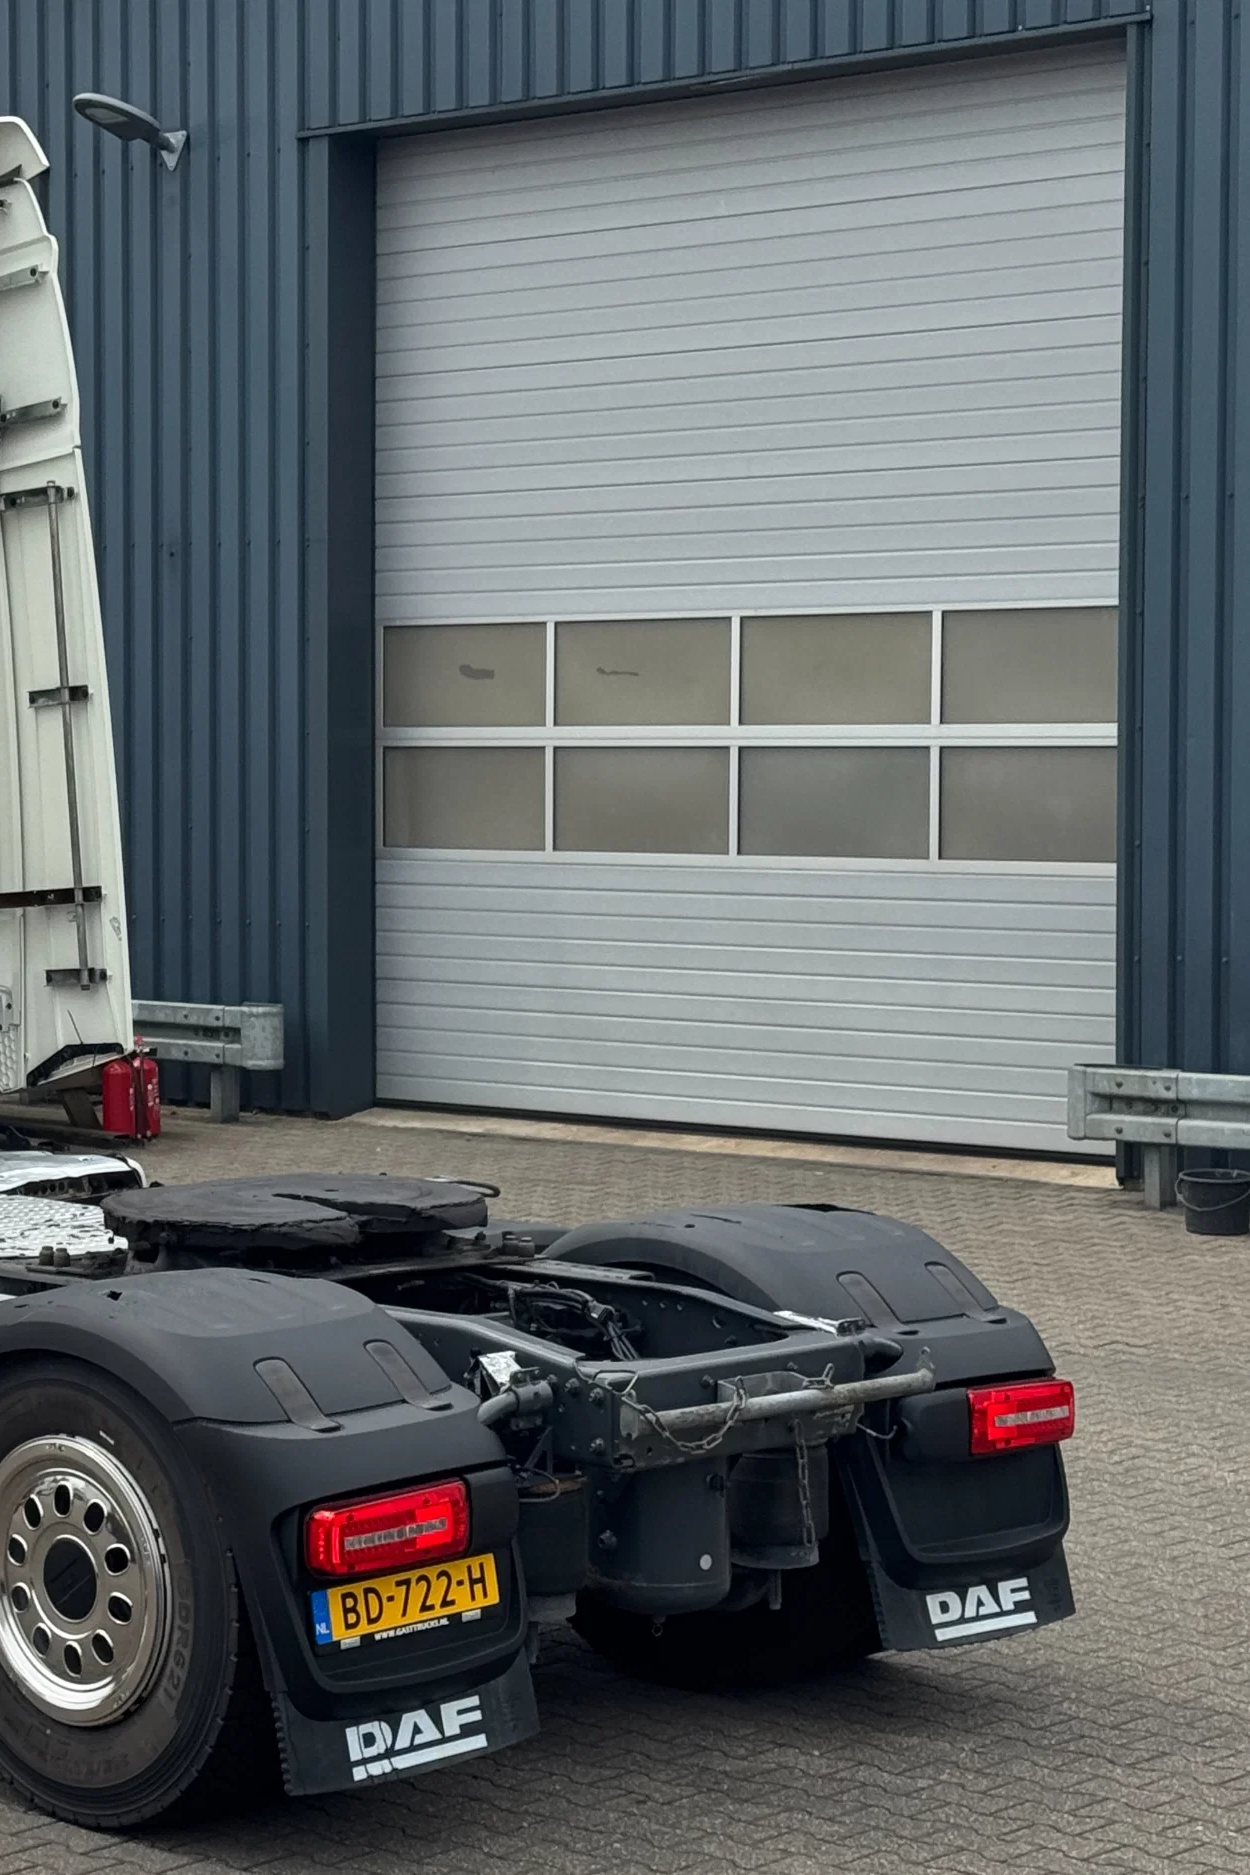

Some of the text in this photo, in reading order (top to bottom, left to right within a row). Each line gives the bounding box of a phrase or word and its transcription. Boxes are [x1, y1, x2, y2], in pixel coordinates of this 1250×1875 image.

[340, 1561, 488, 1631] BD-722-H
[925, 1576, 1032, 1625] DAF
[315, 1622, 330, 1636] NL
[345, 1695, 483, 1763] DAF
